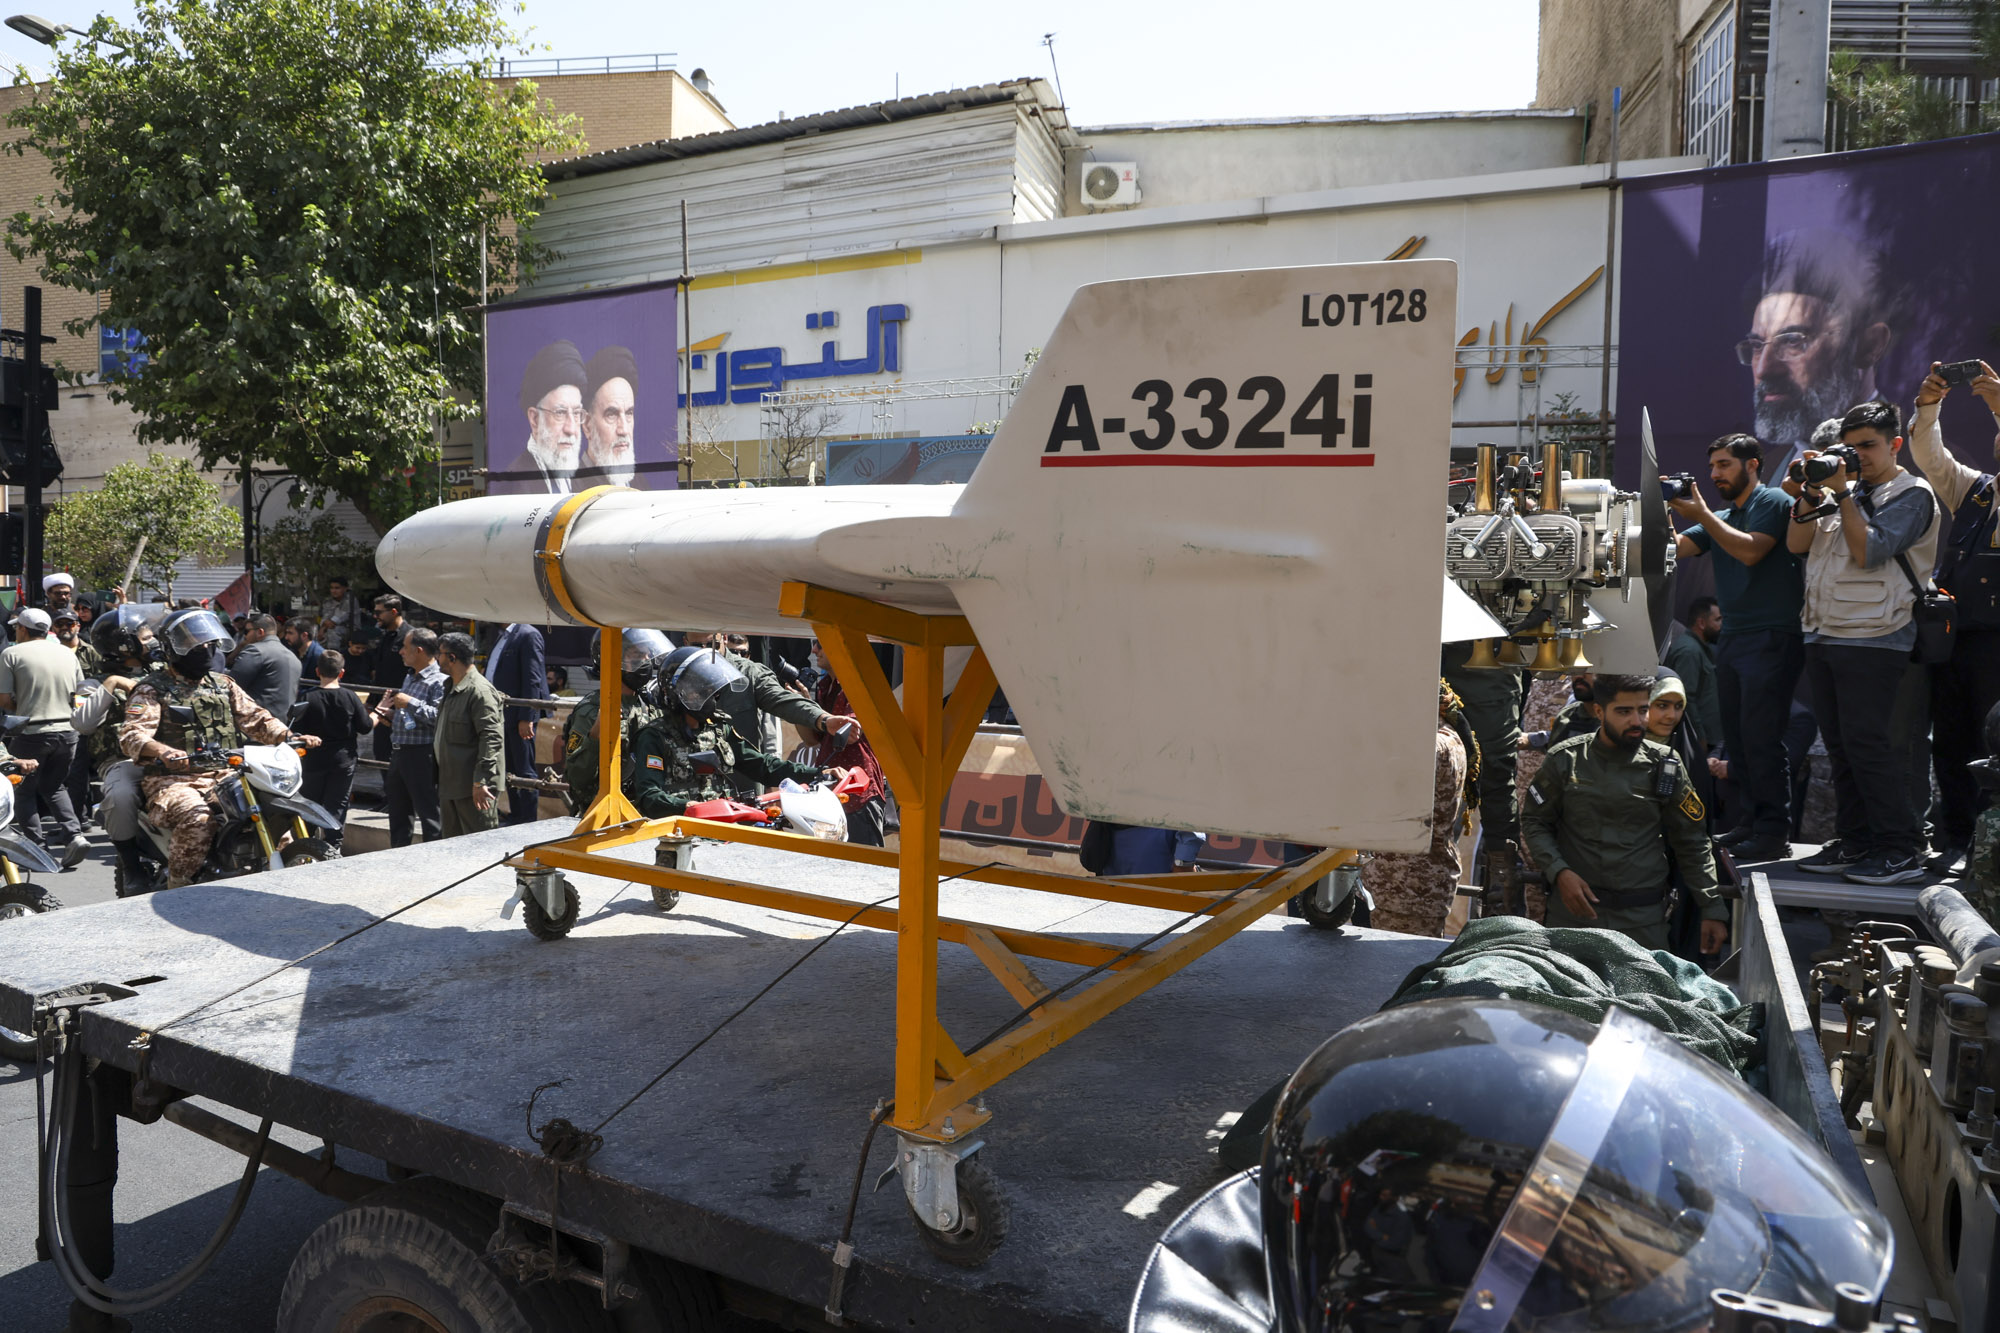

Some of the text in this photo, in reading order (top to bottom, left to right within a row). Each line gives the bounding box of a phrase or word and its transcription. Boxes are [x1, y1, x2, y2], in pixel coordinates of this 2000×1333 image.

[1301, 288, 1428, 328] LOT128
[1044, 373, 1373, 453] A-3324i
[523, 506, 542, 528] 3324
